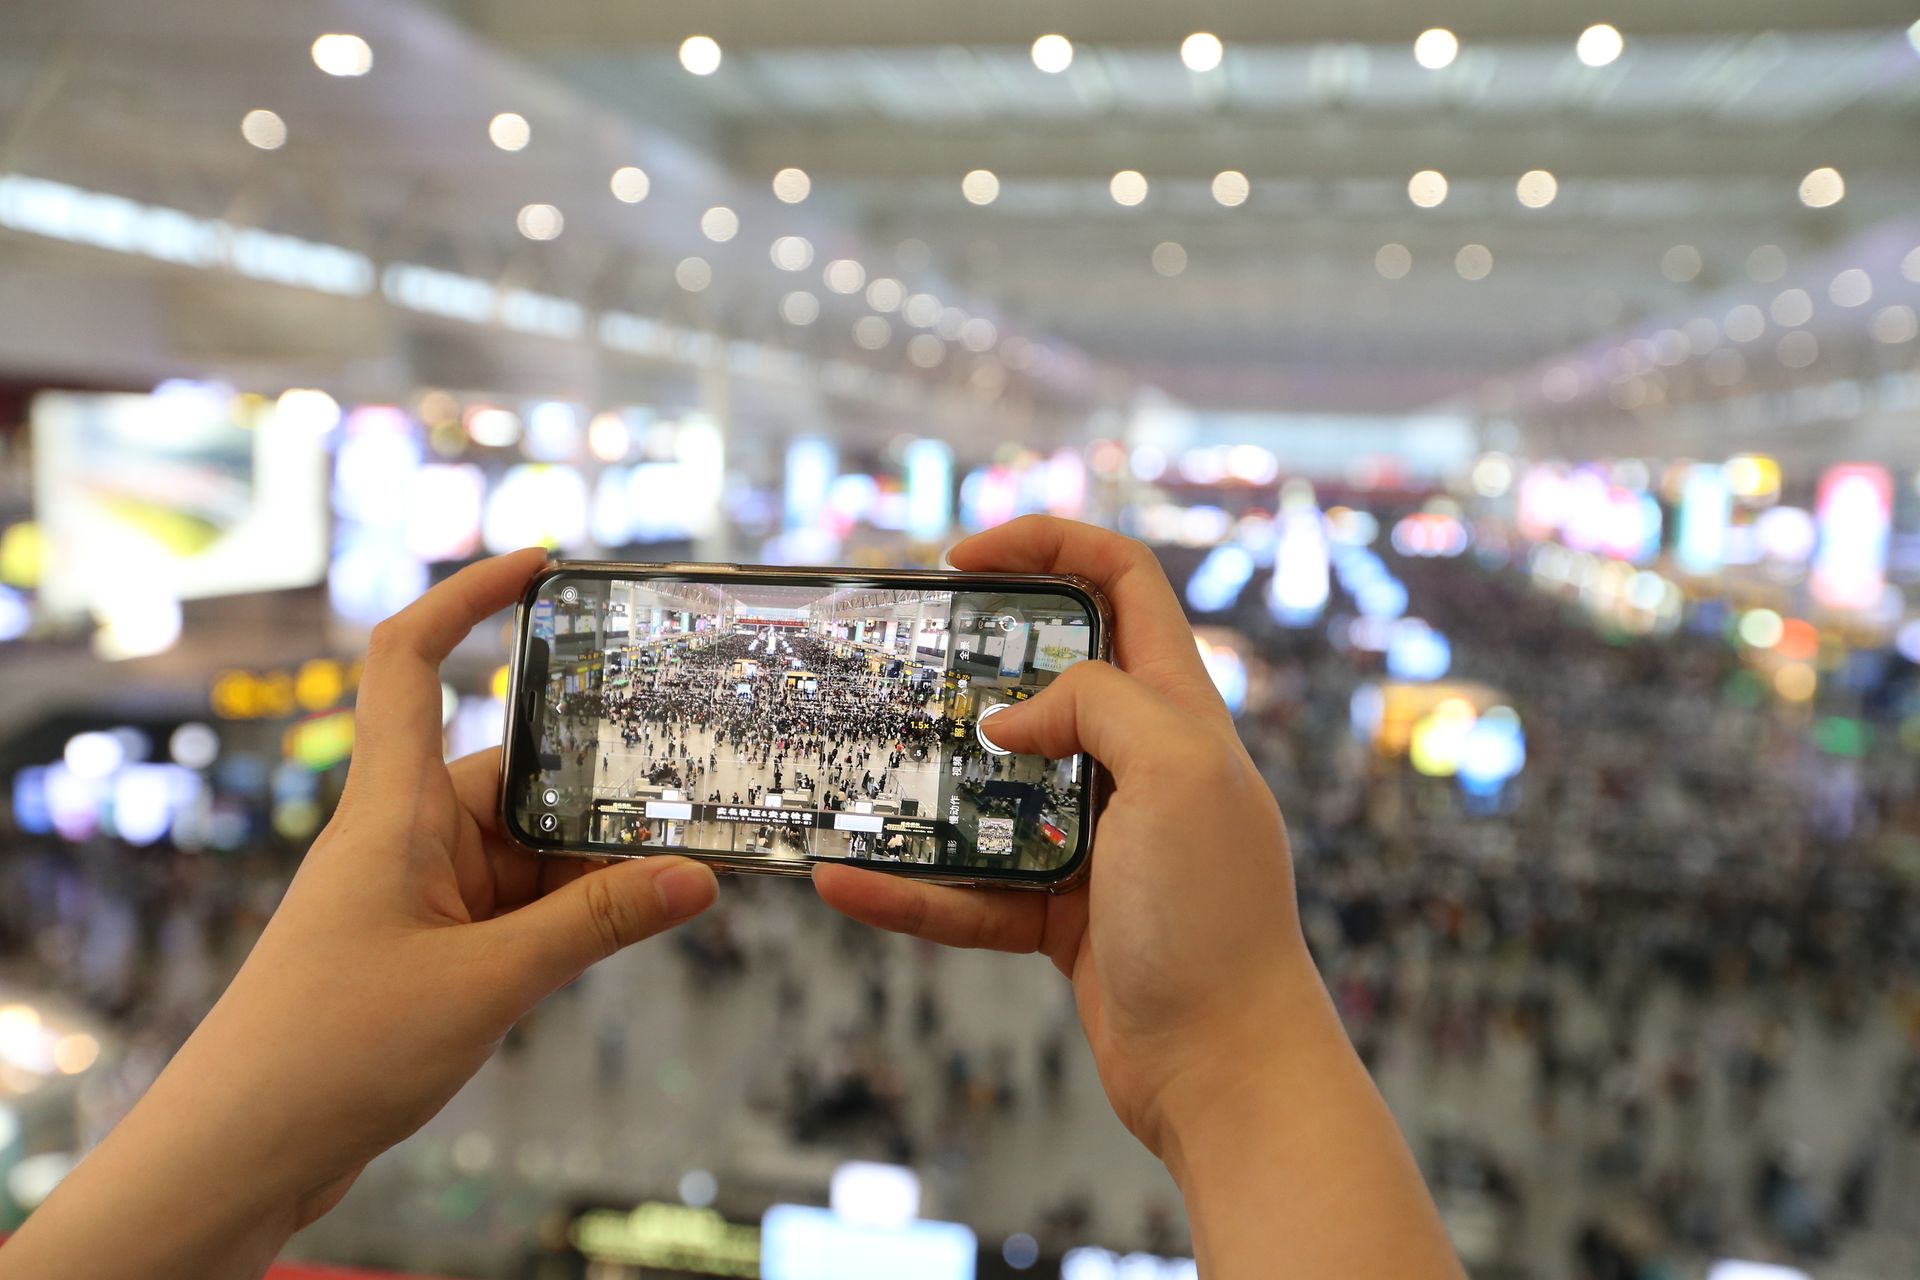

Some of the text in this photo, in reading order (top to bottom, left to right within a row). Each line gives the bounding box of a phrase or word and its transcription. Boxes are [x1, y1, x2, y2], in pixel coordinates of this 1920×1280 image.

[960, 641, 970, 660] 全景
[957, 679, 969, 699] 人像
[910, 721, 930, 729] 1.5x
[954, 718, 965, 738] 照片
[913, 749, 922, 757] .5
[952, 756, 963, 776] 视频
[949, 795, 960, 825] 慢动作
